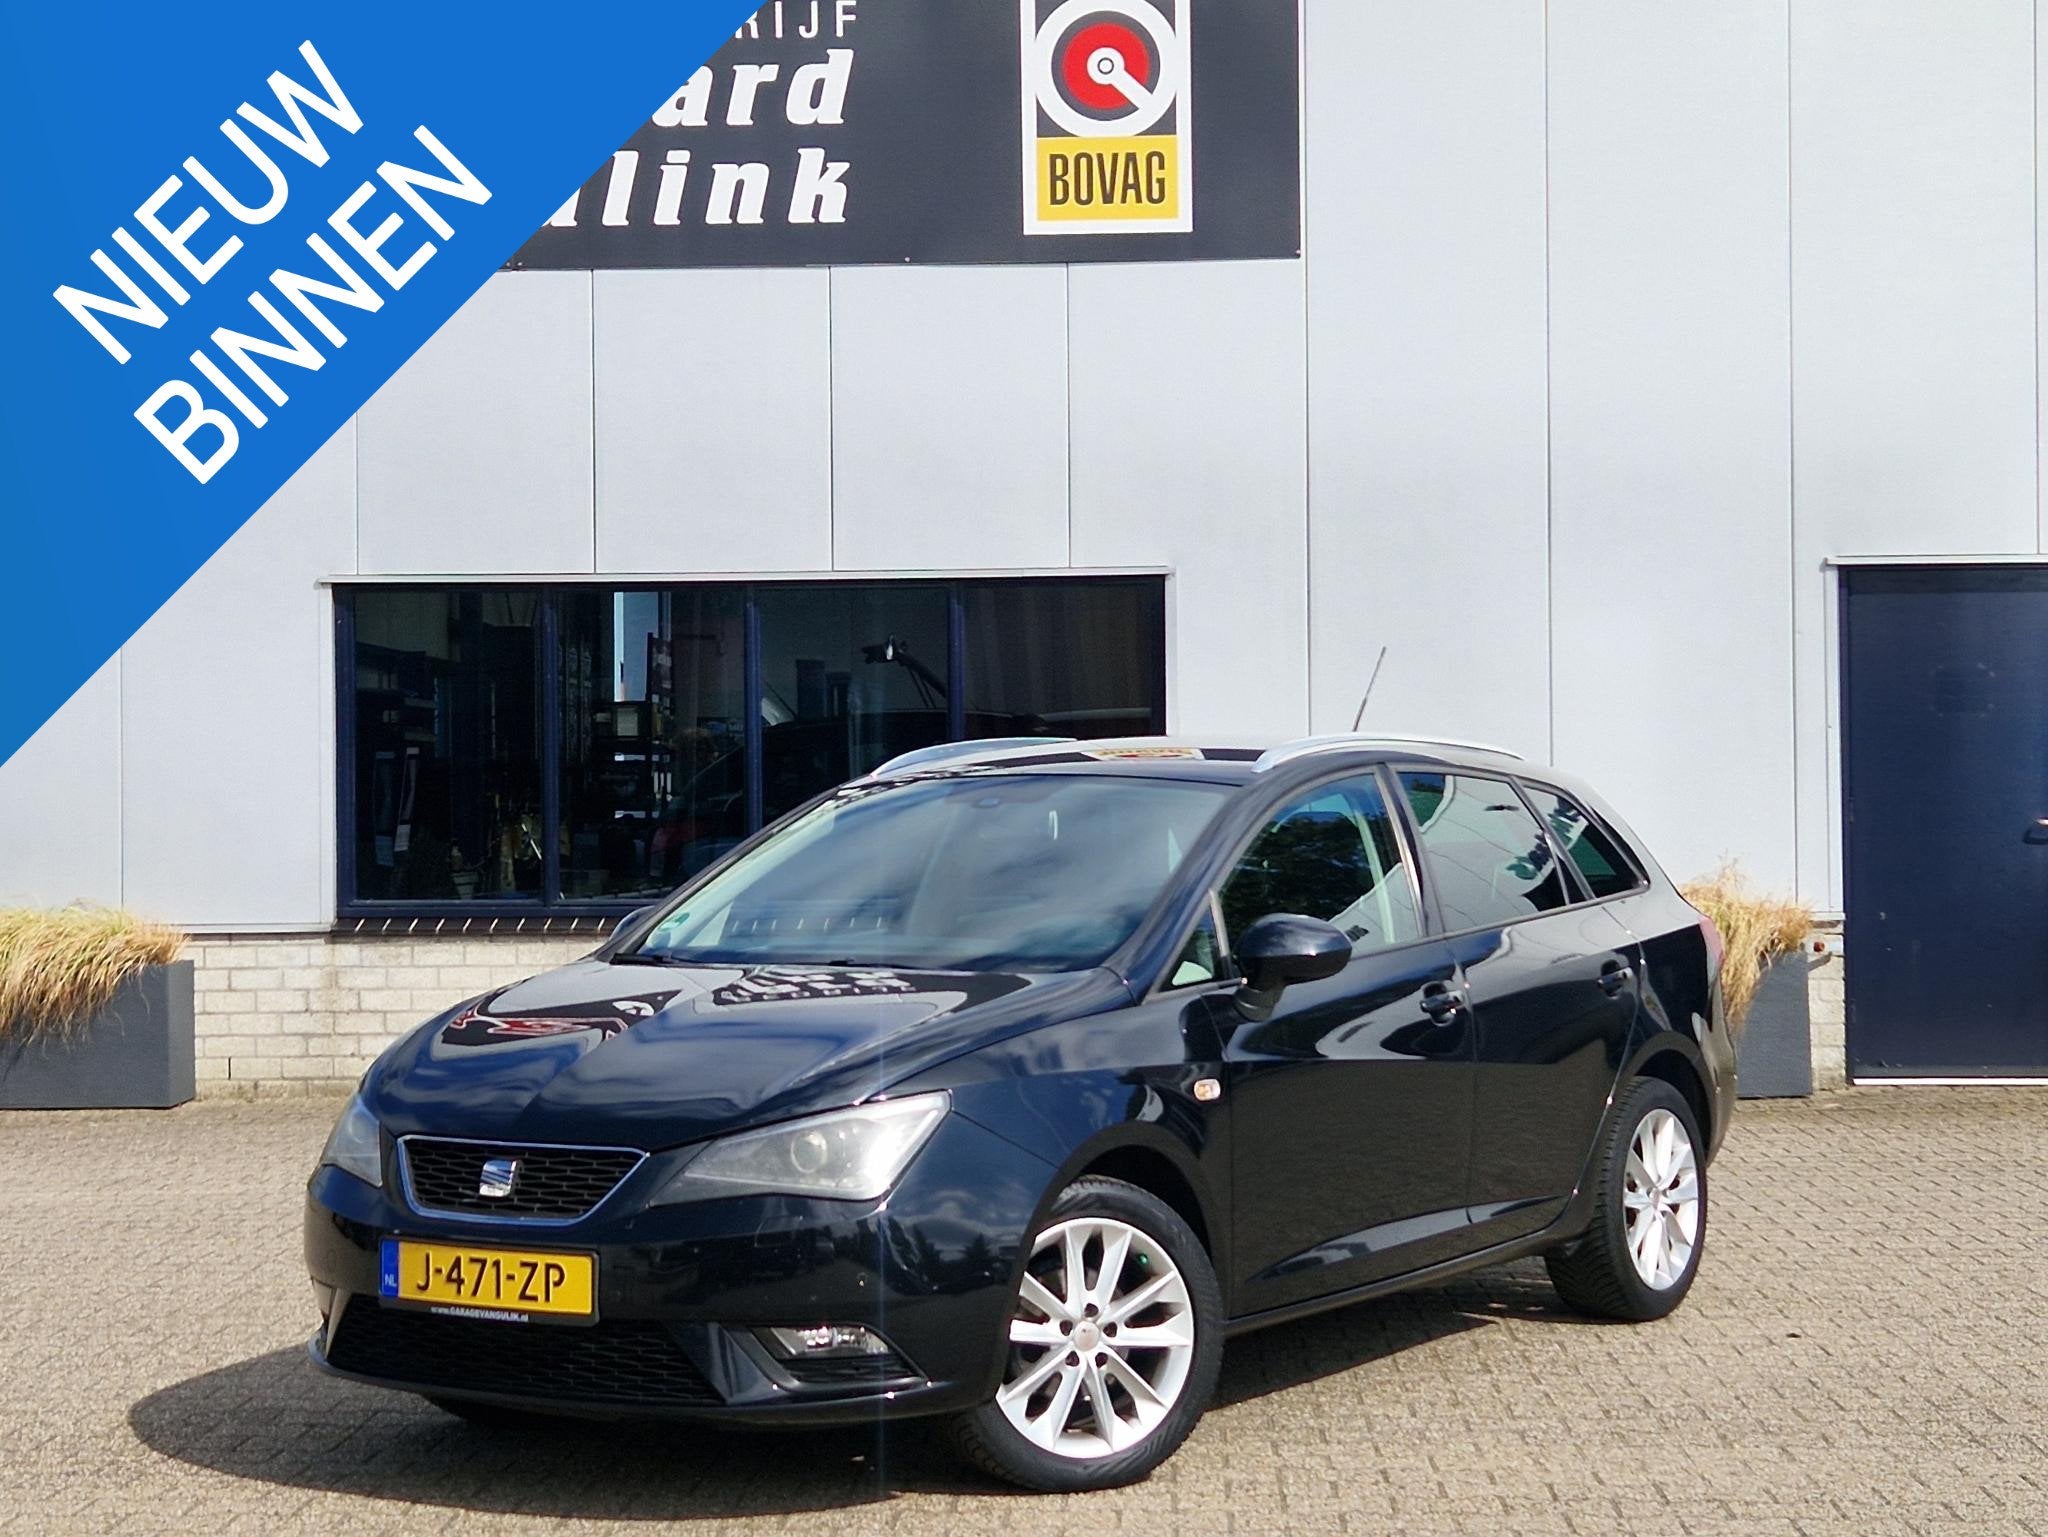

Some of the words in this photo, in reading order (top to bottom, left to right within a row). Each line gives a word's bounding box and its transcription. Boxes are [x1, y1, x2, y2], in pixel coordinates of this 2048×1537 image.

[1049, 150, 1166, 206] BOVAG
[384, 1273, 397, 1287] NL
[416, 1251, 566, 1303] J-471-ZP
